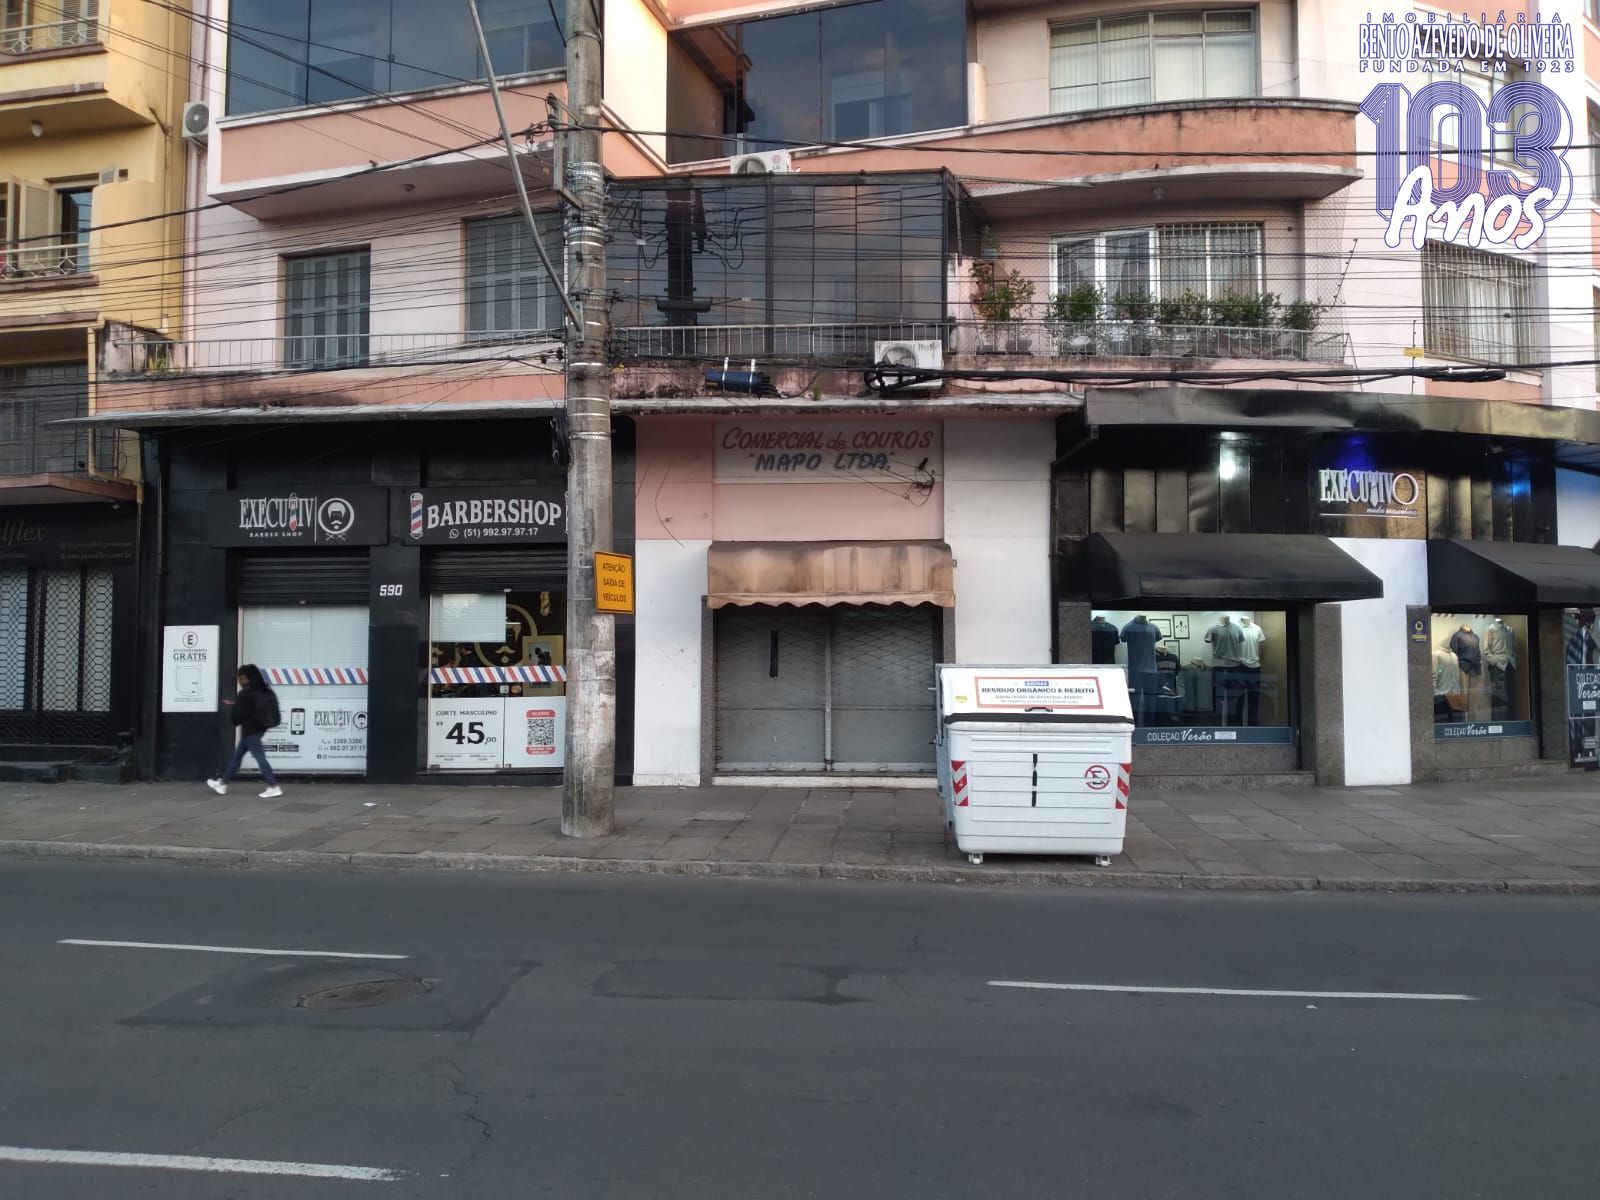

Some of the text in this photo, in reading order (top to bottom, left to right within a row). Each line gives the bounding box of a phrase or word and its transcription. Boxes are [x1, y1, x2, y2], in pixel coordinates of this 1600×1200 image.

[826, 431, 847, 450] de
[851, 429, 933, 449] COUROS
[1319, 468, 1419, 506] EXECUTIVO
[427, 499, 562, 529] BARBERSHOP
[0, 519, 45, 546] lflex
[463, 527, 539, 539] (51) 992.97.97.17
[379, 584, 403, 596] 590
[187, 634, 194, 645] E
[1180, 728, 1212, 741] Verão
